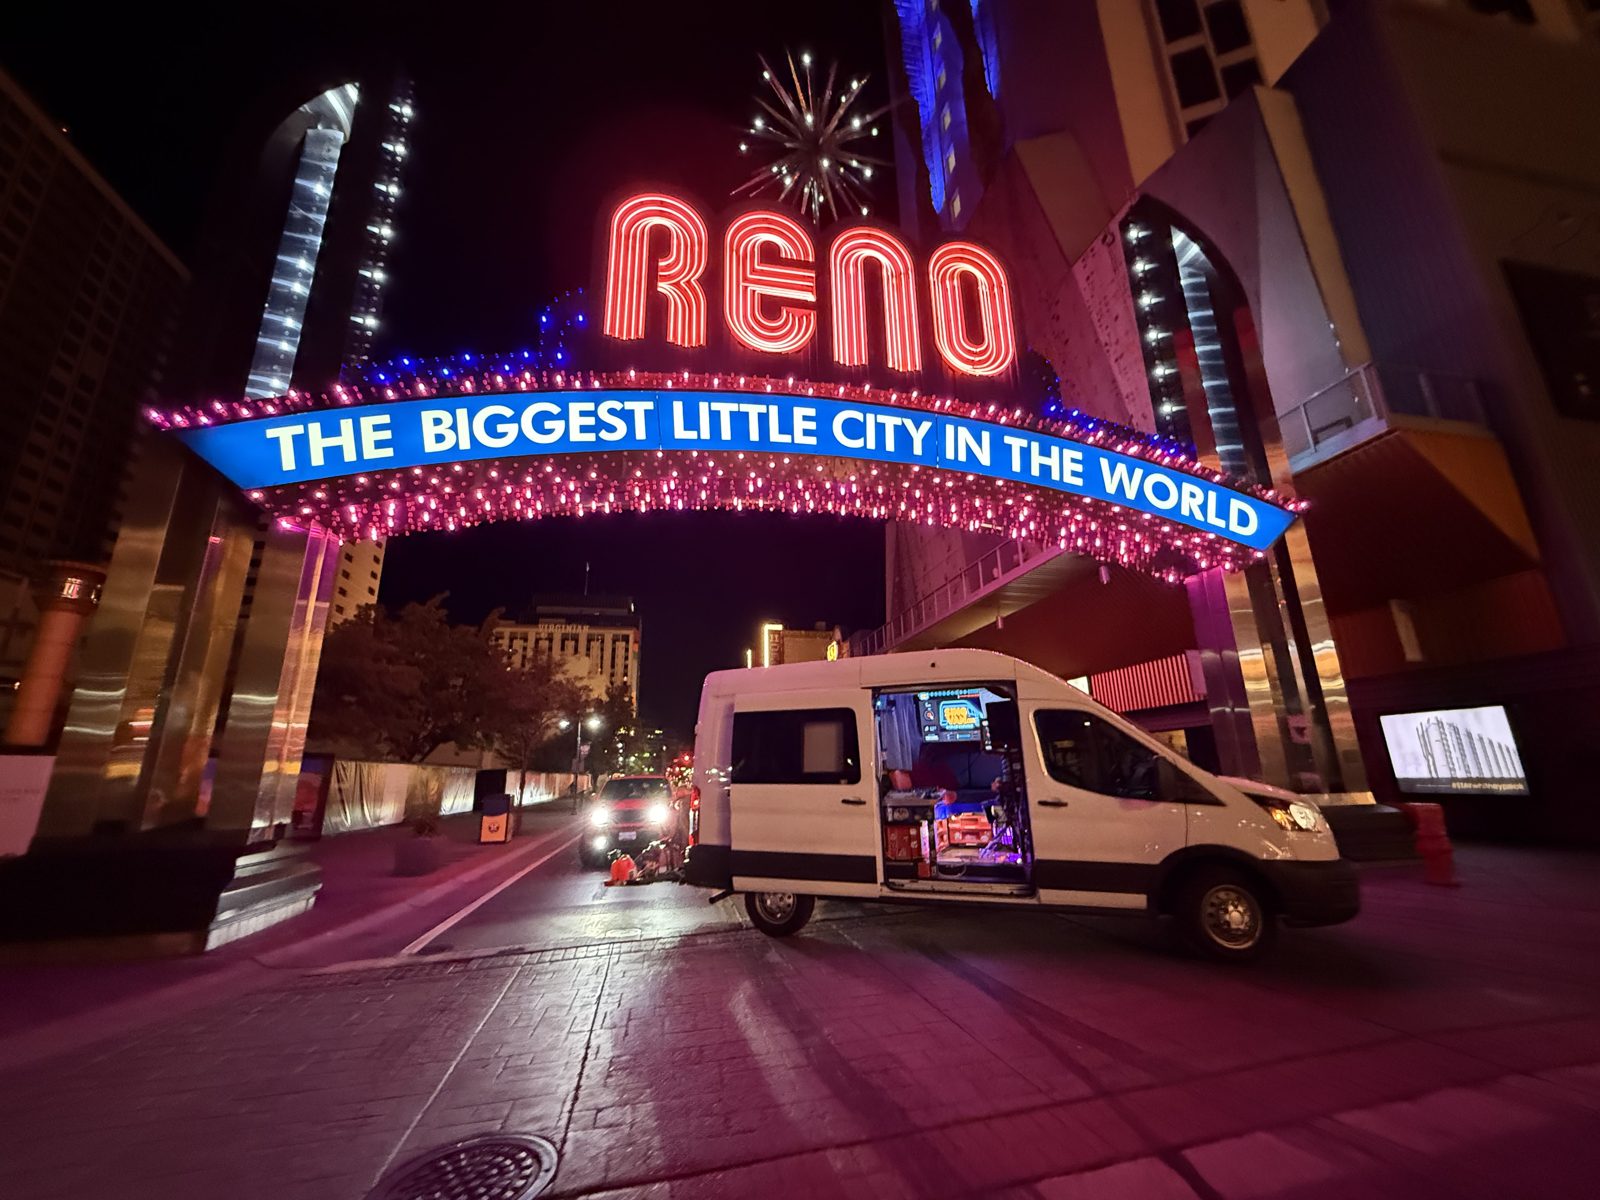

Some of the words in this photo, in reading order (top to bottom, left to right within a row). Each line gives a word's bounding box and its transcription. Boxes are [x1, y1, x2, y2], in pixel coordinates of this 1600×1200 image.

[603, 192, 1017, 377] RENO
[265, 413, 395, 472] THE
[420, 400, 655, 454] BIGGEST
[672, 400, 818, 446] LITTLE
[831, 409, 933, 456] CITY
[944, 423, 992, 467] IN
[1003, 434, 1084, 487] THE
[1099, 456, 1259, 537] WORLD
[538, 623, 590, 633] VIRGINIAN
